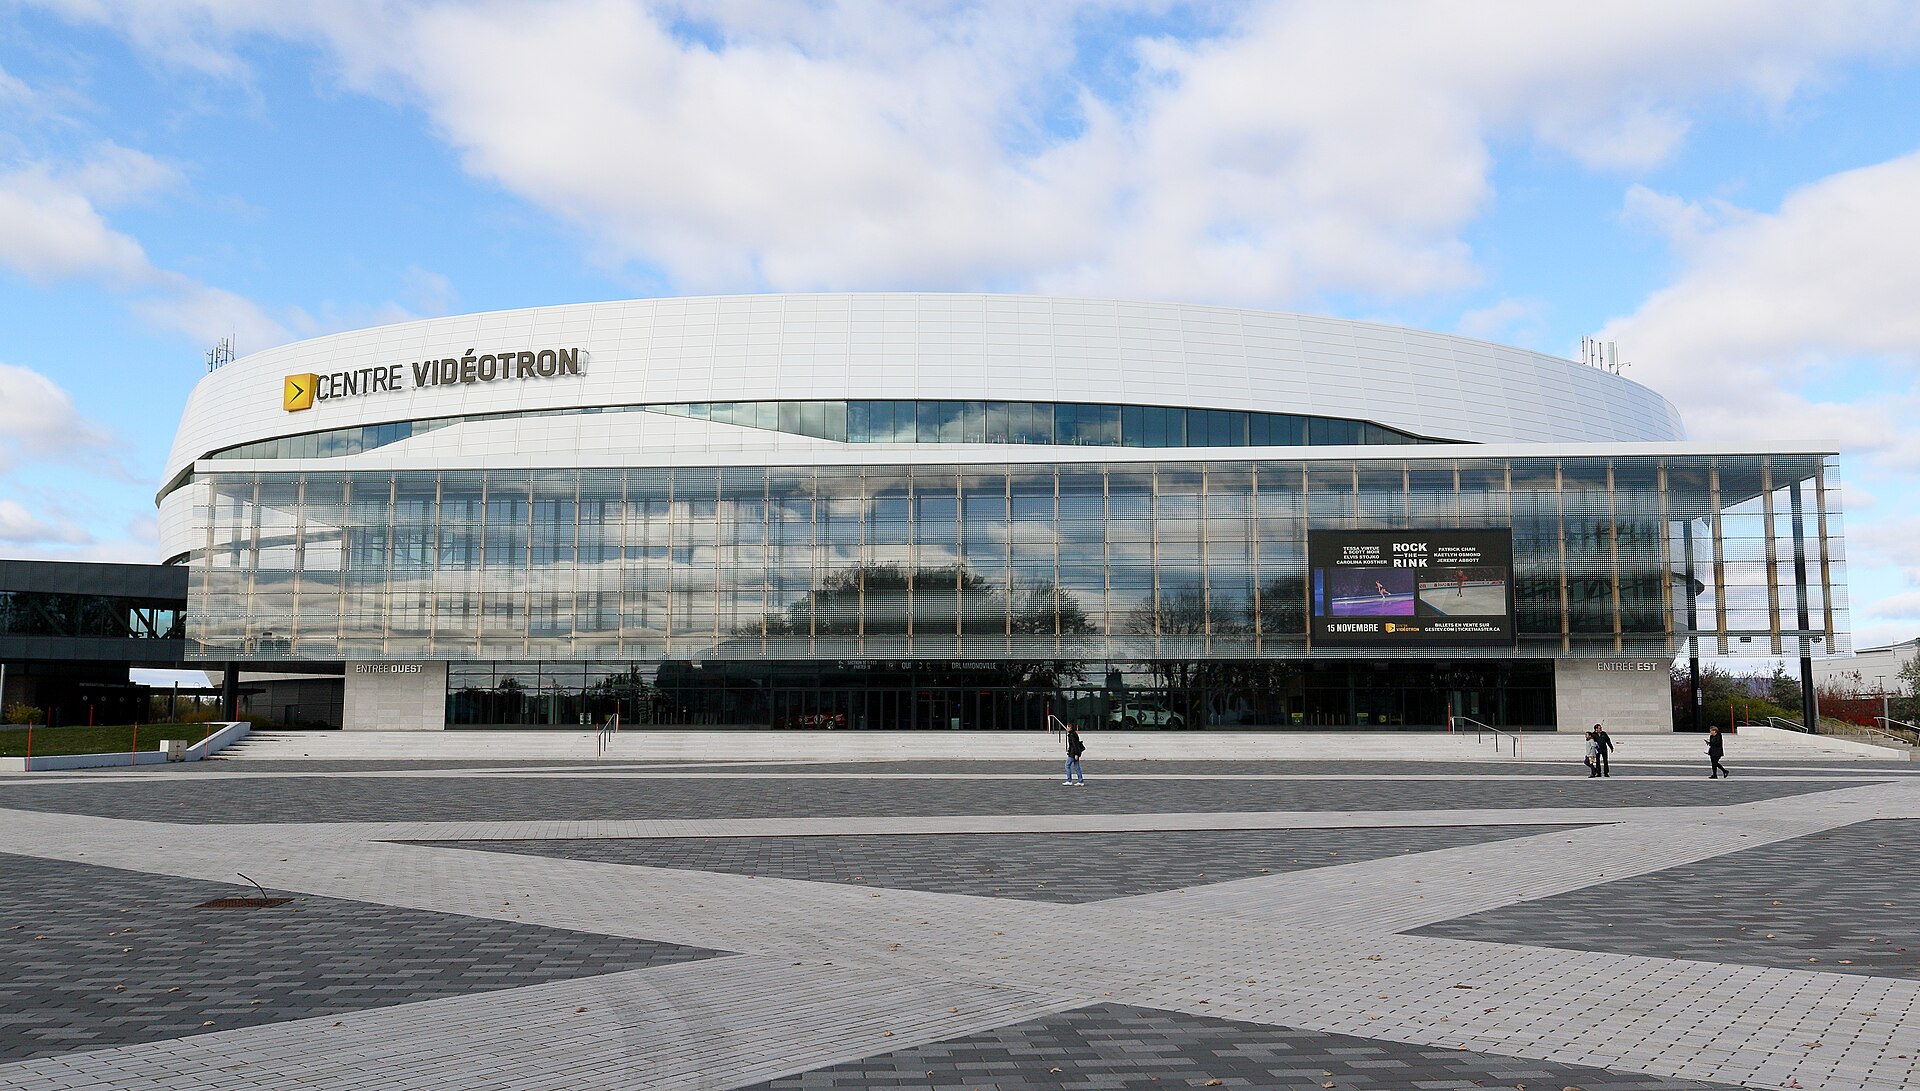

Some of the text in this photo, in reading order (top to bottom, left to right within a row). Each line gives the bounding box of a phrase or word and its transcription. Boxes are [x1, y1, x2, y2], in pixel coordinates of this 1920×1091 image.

[316, 347, 579, 401] CENTRE VIDÉOTRON
[1392, 543, 1428, 552] ROCK
[1393, 558, 1428, 568] RINK
[1327, 623, 1379, 632] 15 NOVEMBRE
[356, 663, 423, 673] ENTRÉE OUEST
[1597, 660, 1658, 671] ENTRÉE EST
